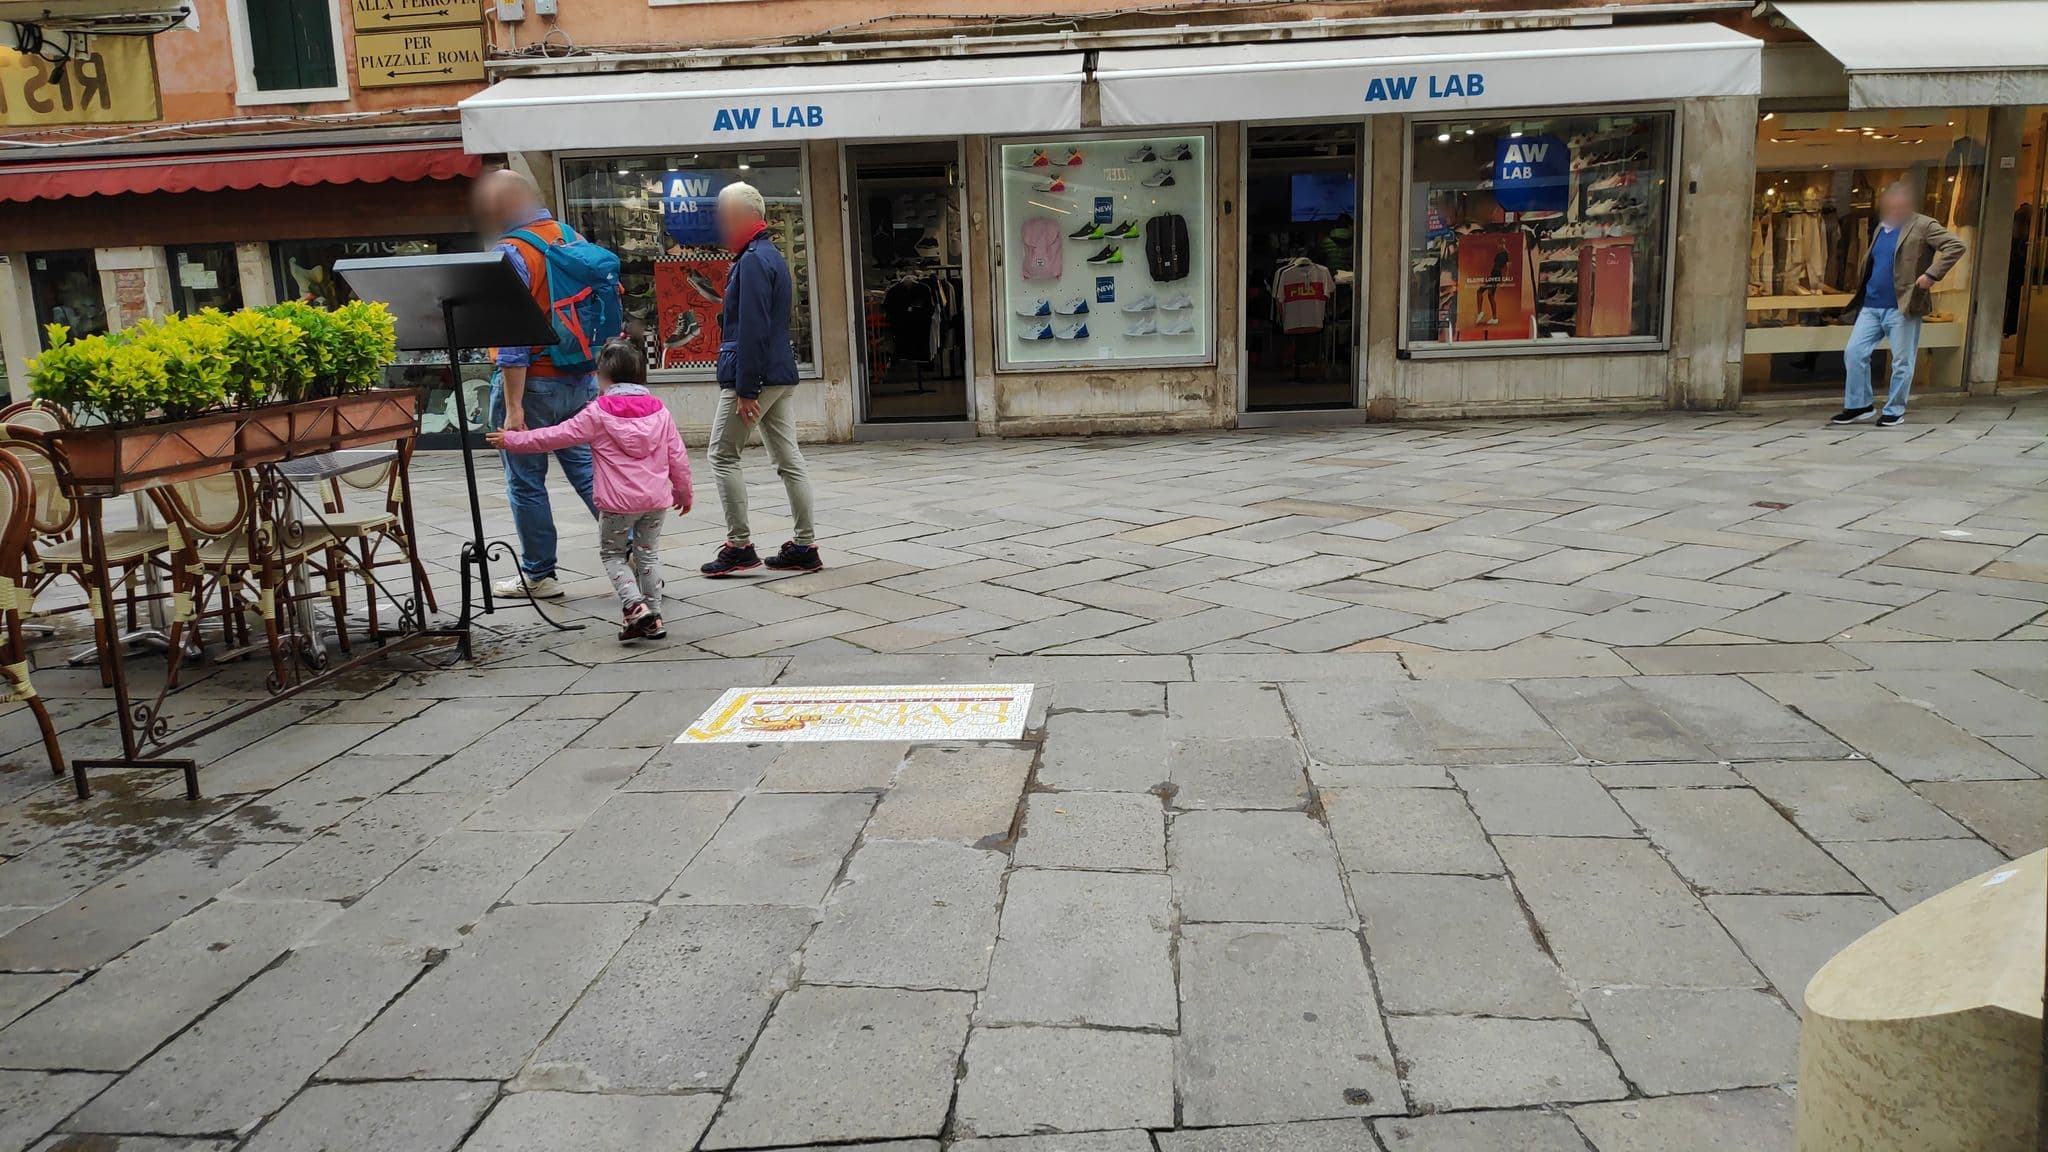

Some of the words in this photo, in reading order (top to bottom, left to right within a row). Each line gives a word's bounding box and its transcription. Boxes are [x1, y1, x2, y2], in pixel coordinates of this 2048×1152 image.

[402, 0, 476, 8] FERR
[404, 36, 432, 49] PER
[361, 52, 431, 68] PIAZZALE
[438, 50, 480, 64] ROMA
[1364, 76, 1417, 102] AW
[1429, 73, 1485, 98] LAB
[713, 107, 761, 131] AW
[772, 105, 824, 128] LAB
[1503, 143, 1549, 164] AW
[1502, 166, 1533, 180] LAB
[670, 178, 711, 198] AW
[670, 200, 699, 213] LAB
[1095, 204, 1112, 213] NEW
[1096, 283, 1114, 293] NEW
